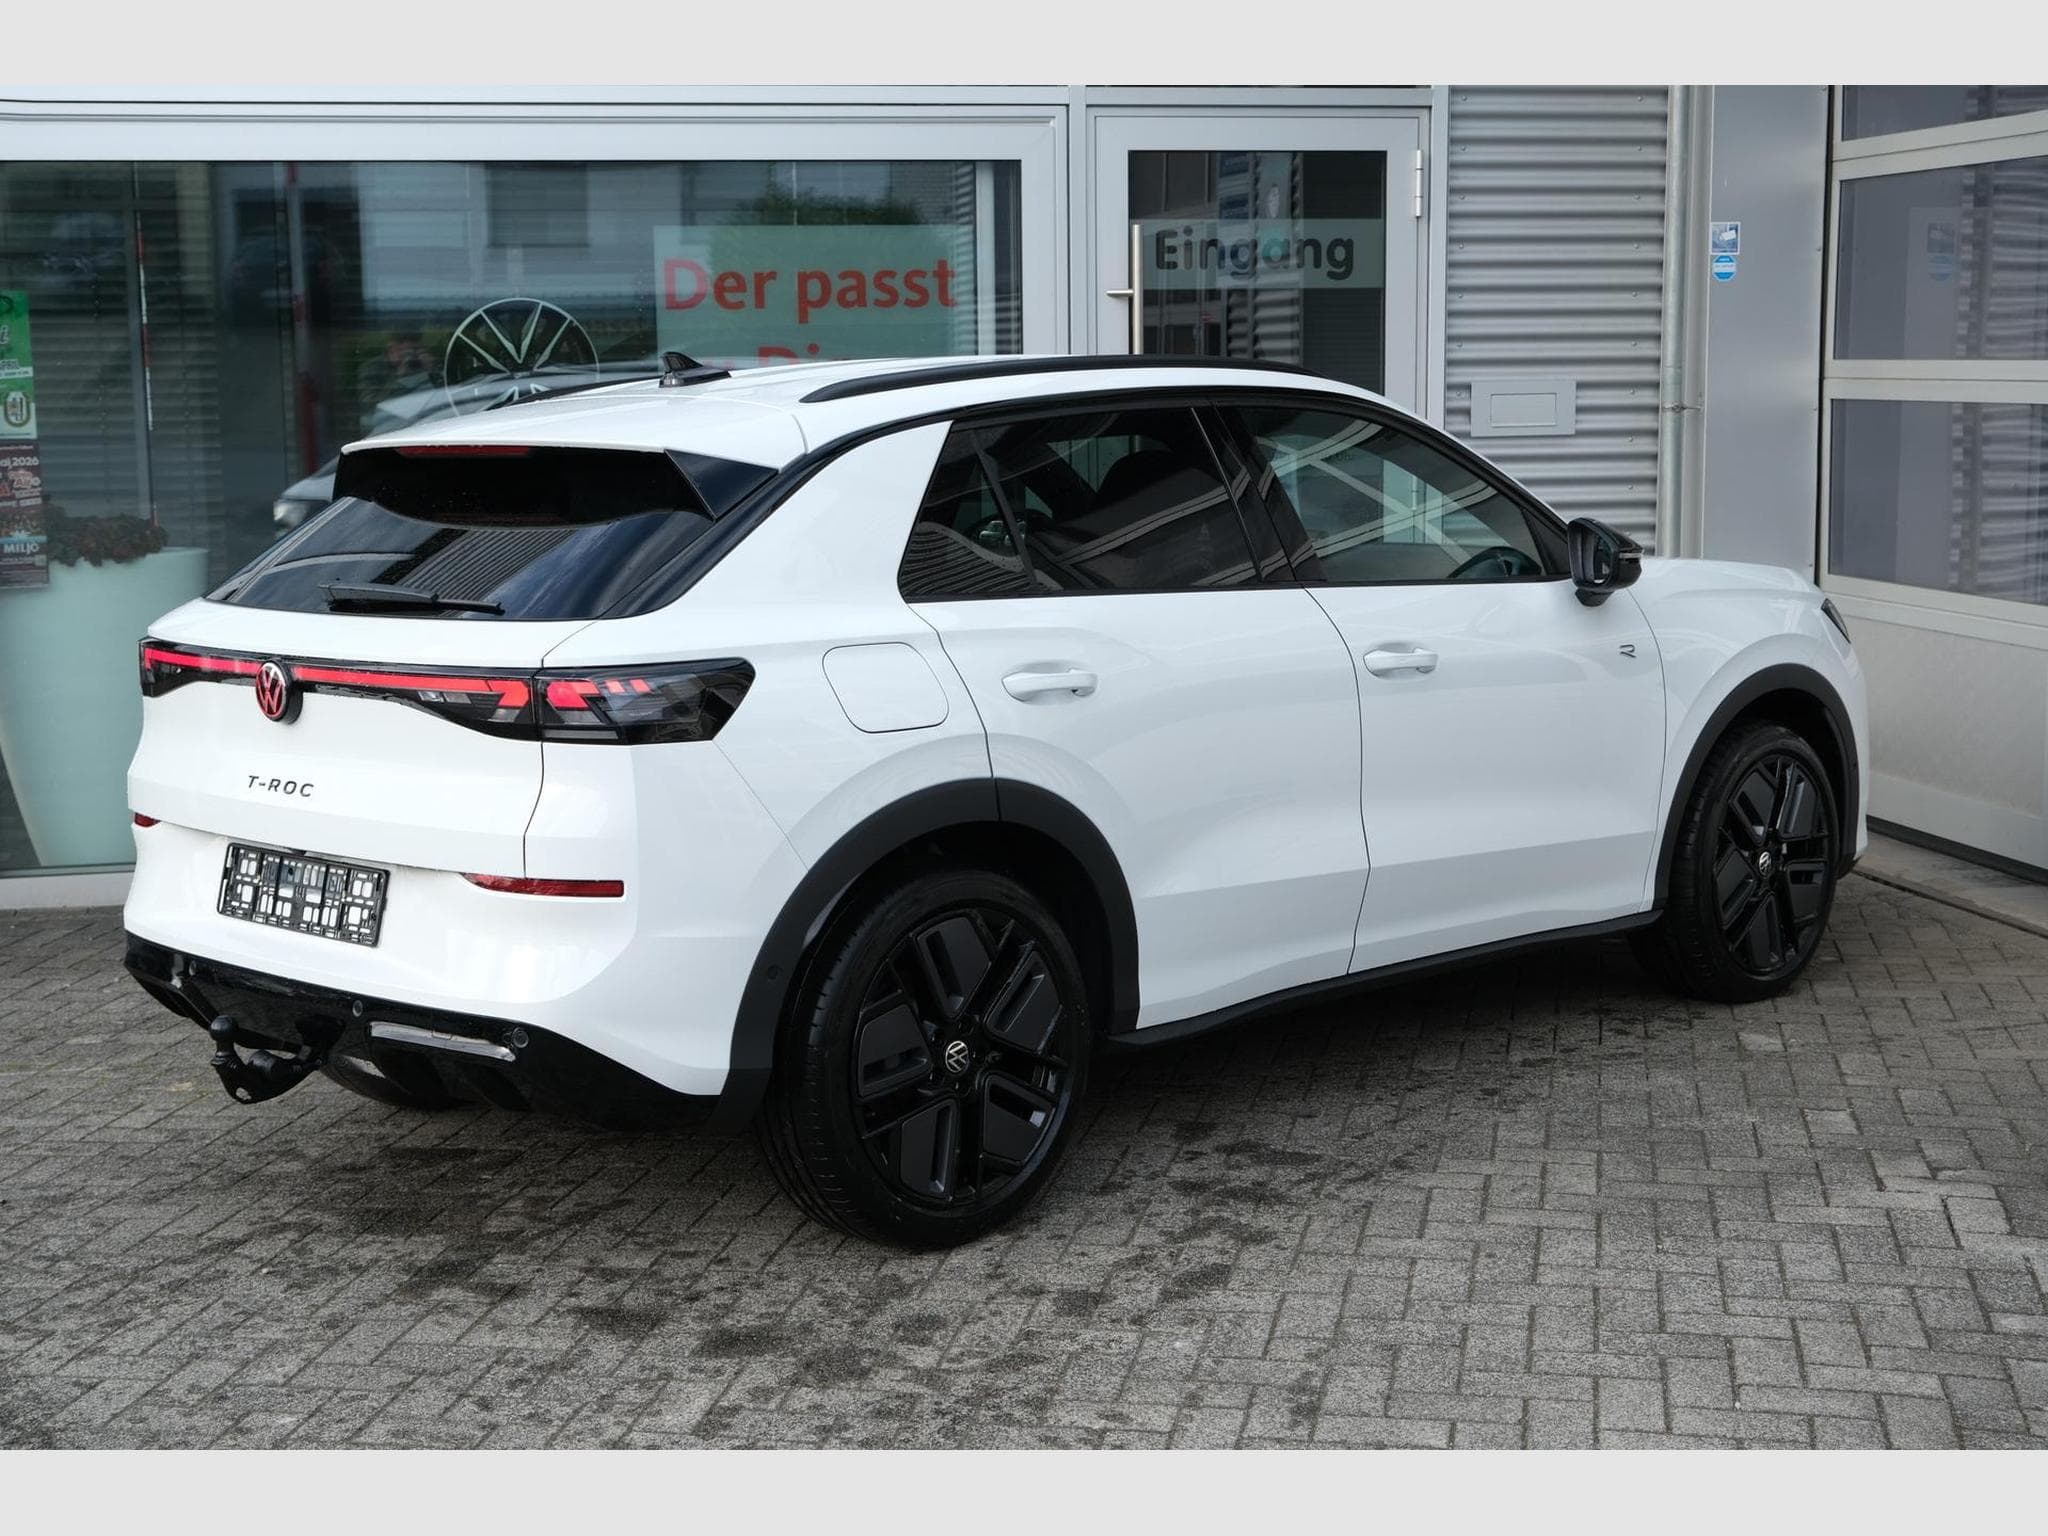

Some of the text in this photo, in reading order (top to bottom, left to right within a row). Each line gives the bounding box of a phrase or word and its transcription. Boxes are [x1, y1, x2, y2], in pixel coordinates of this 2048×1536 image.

[1155, 225, 1354, 281] Eingang
[664, 258, 959, 325] Der passt
[248, 775, 314, 798] T-ROC
